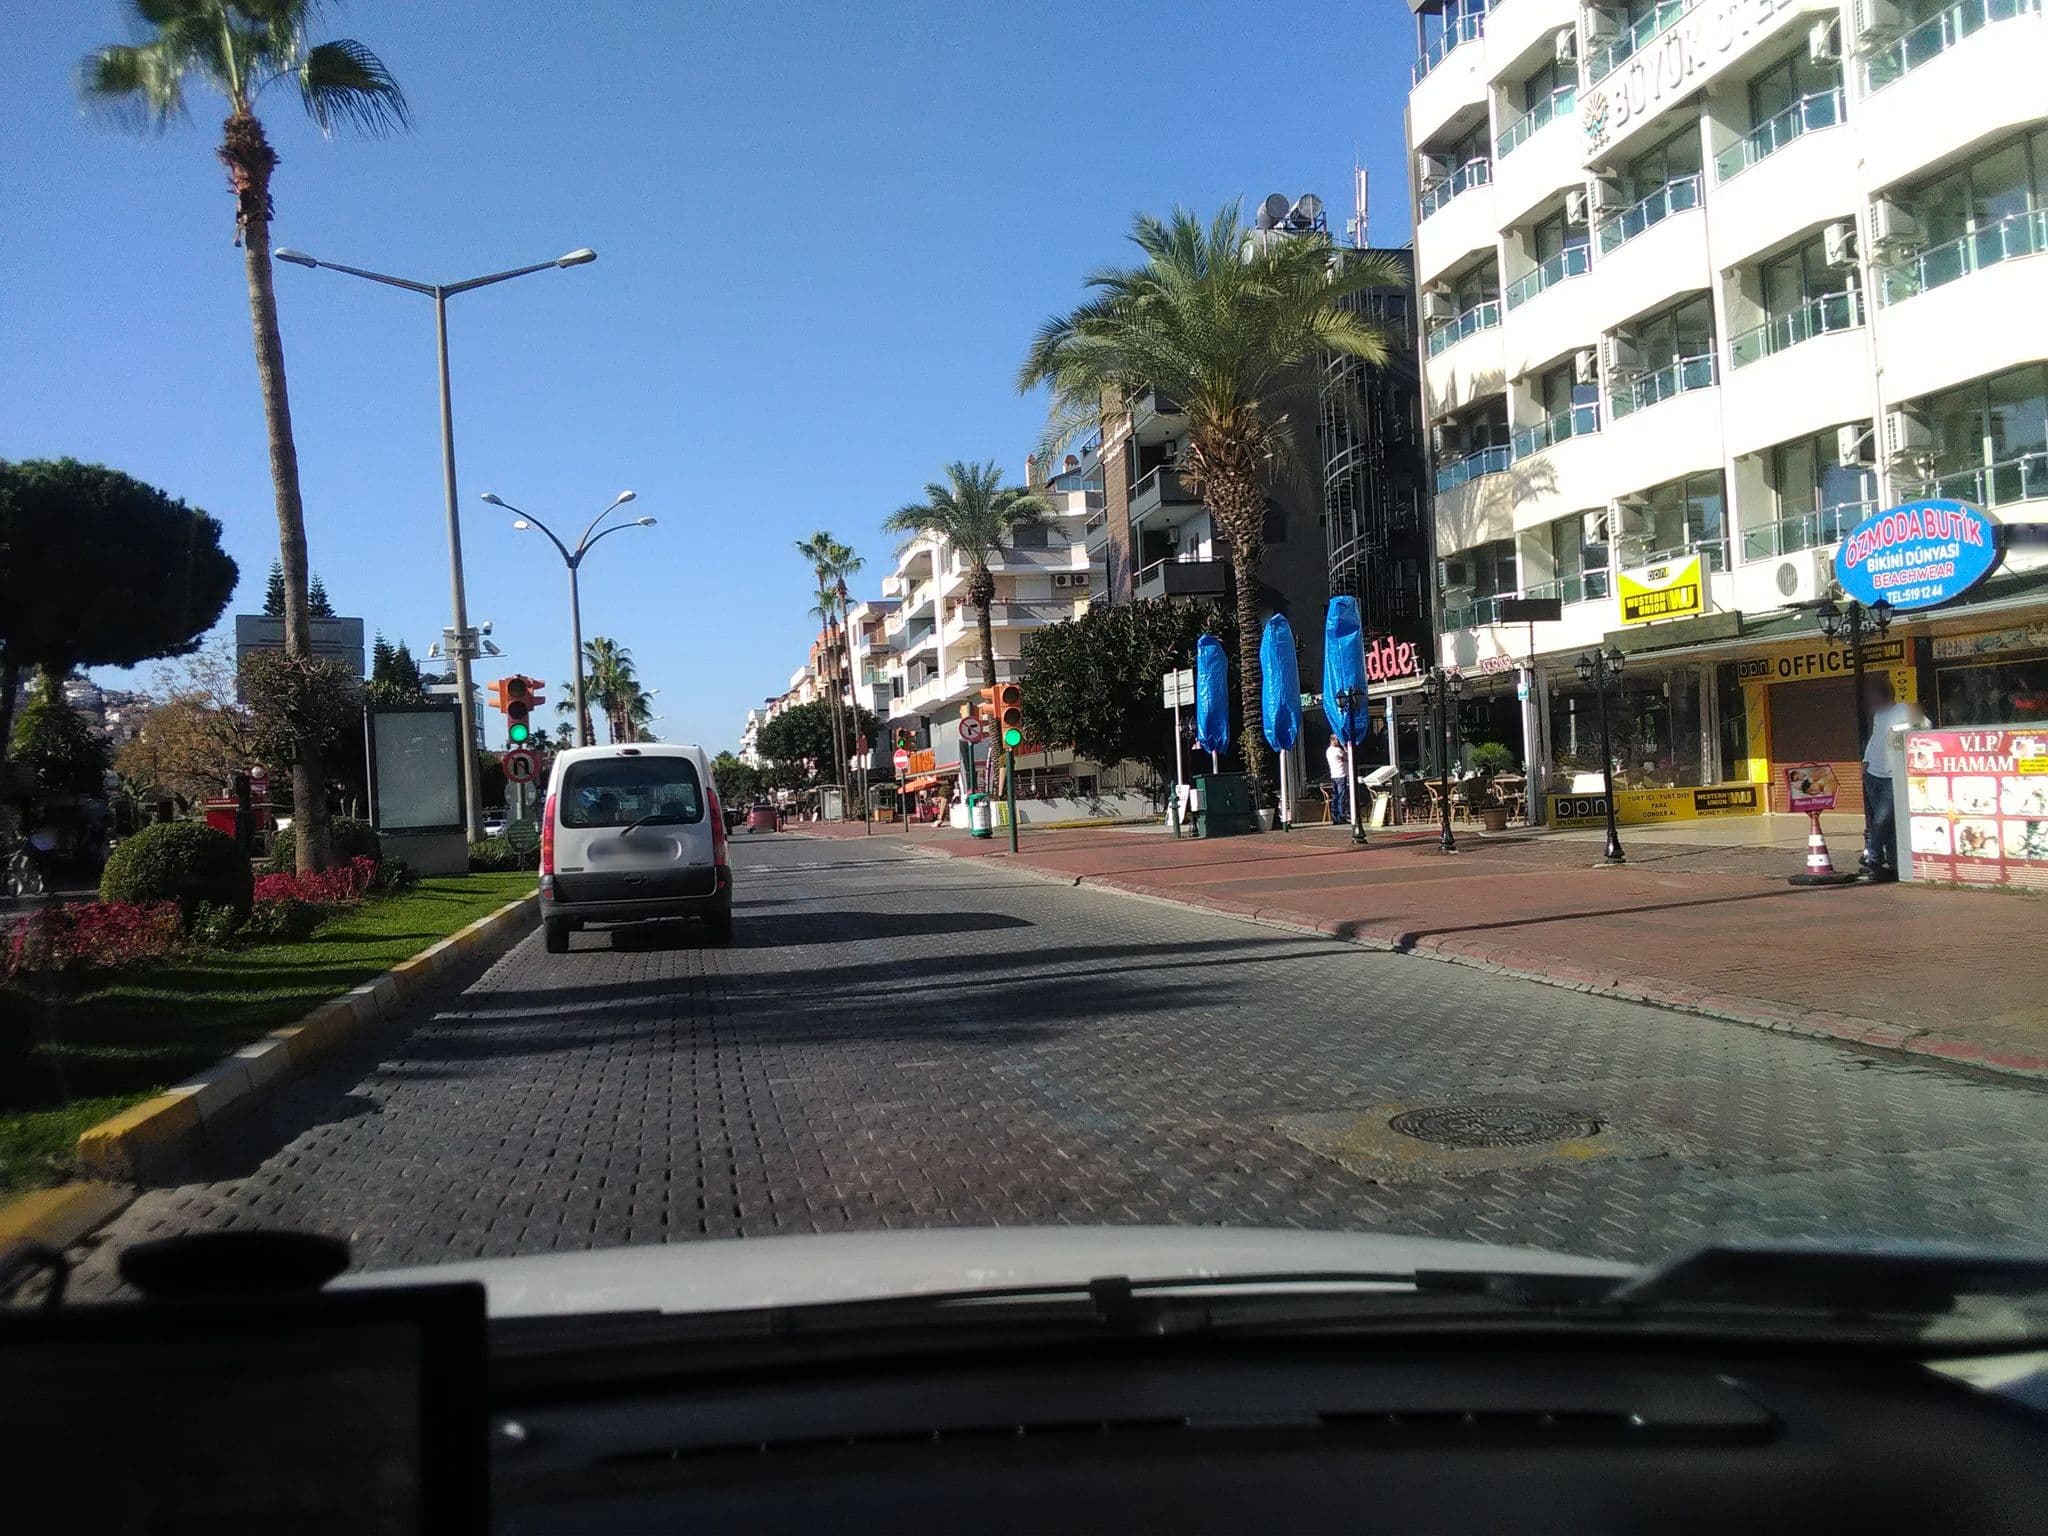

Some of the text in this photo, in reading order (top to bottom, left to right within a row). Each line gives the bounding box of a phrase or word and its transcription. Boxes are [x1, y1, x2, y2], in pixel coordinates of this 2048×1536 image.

[1845, 507, 1983, 568] ÖZMODA BUTİK
[1867, 543, 1960, 573] BİKİNİ DÜNYASI
[1873, 562, 1954, 589] BEACHWEAR
[1625, 591, 1666, 608] WESTERN
[1638, 601, 1667, 615] UNION
[1739, 660, 1769, 677] bpn
[1778, 649, 1855, 677] OFFICE
[1942, 756, 2014, 772] HAMAM
[1697, 792, 1727, 800] WESTERN
[1557, 798, 1608, 818] bpn
